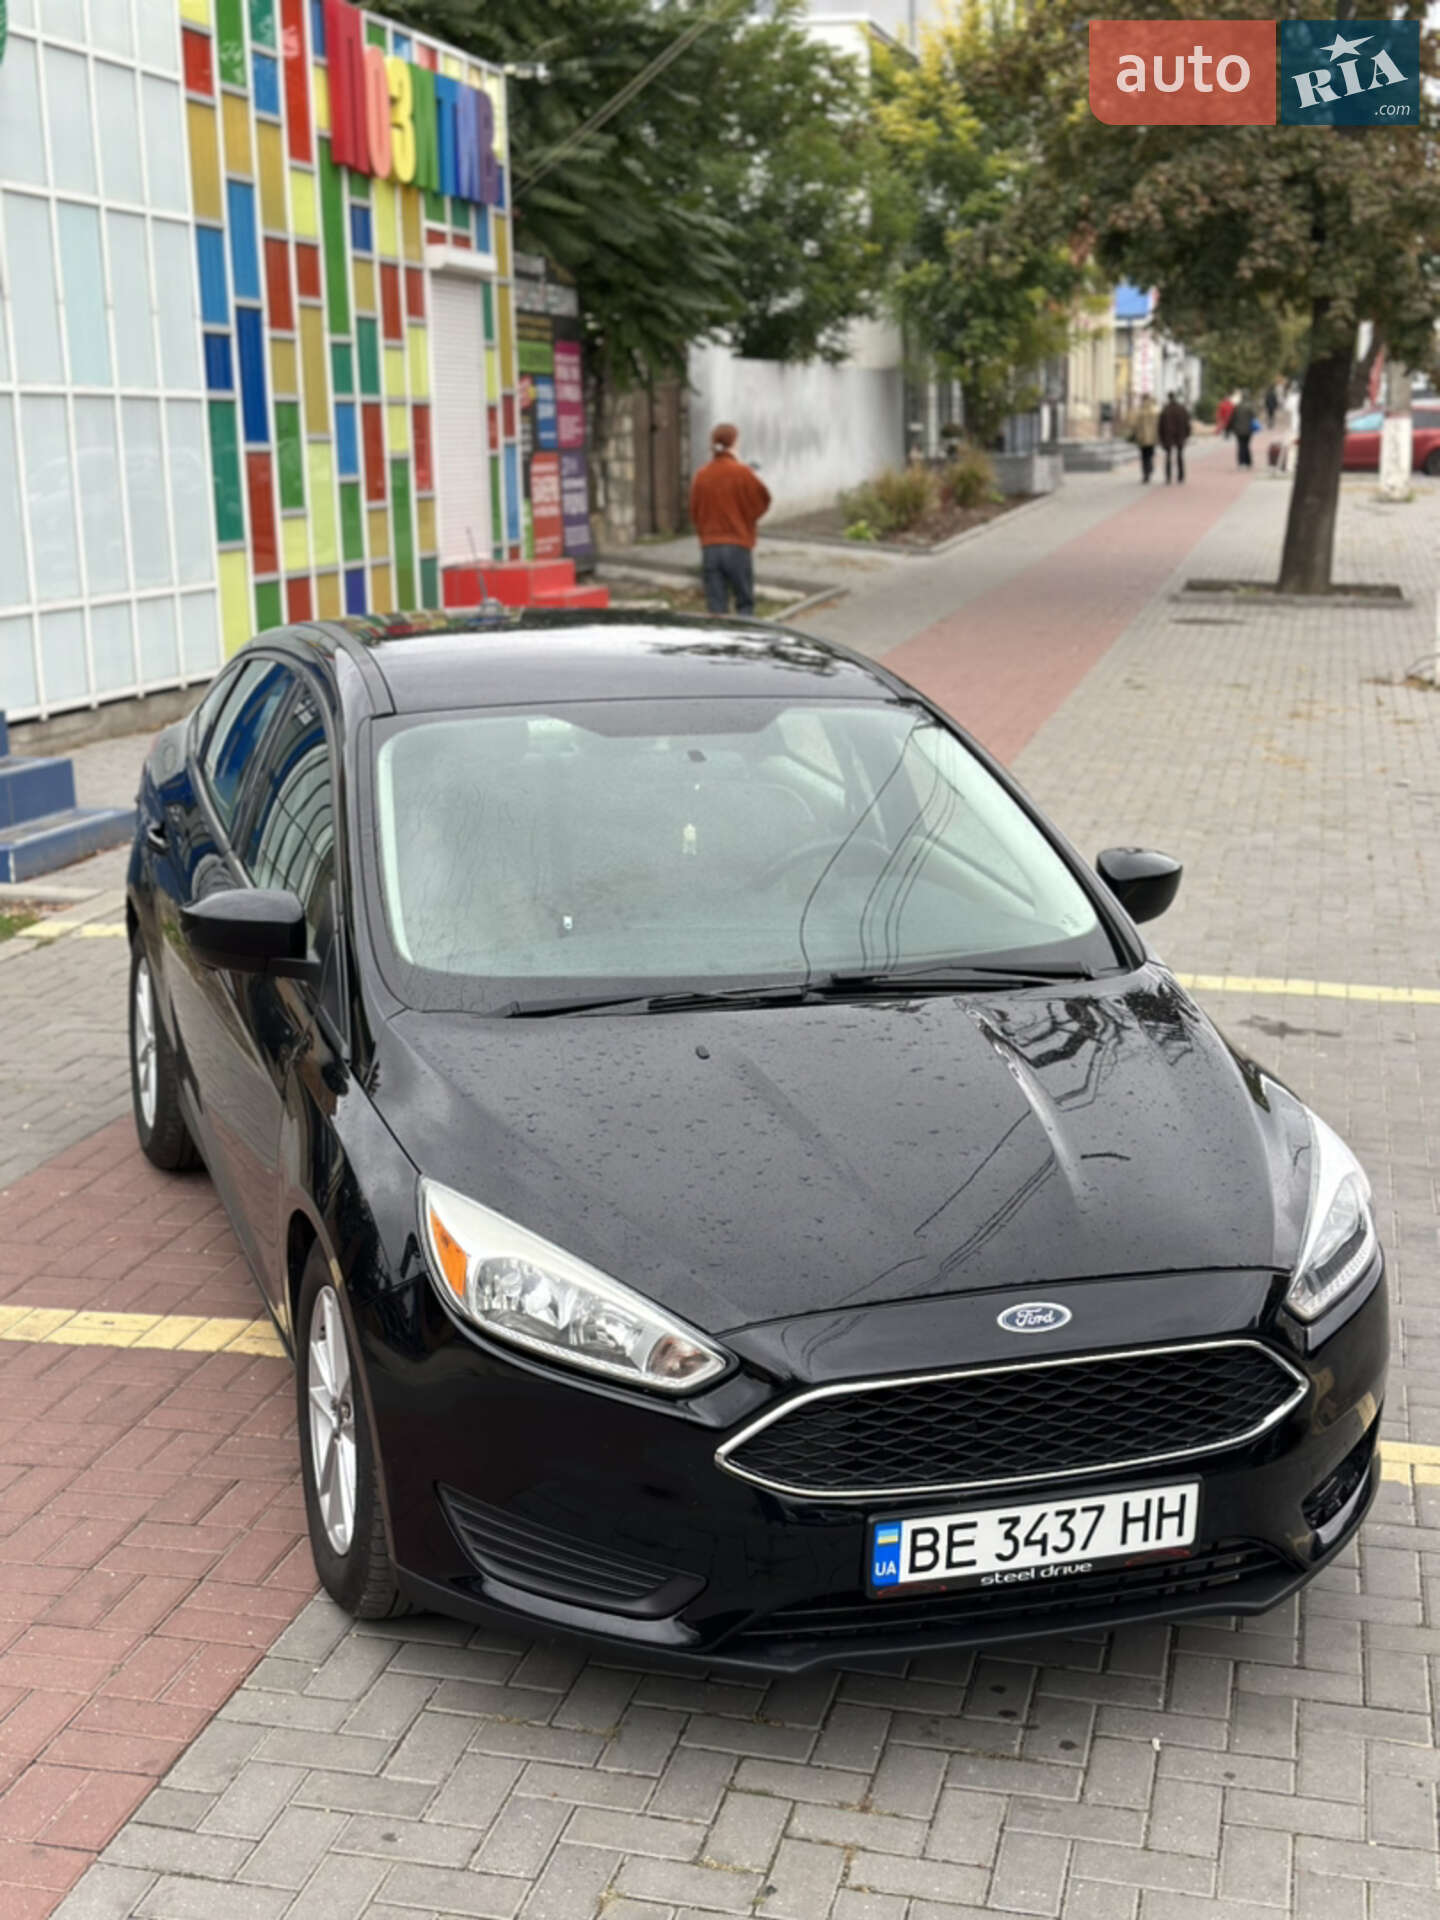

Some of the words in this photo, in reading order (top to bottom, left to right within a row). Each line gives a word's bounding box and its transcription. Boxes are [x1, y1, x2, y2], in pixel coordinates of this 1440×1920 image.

[1014, 1306, 1057, 1327] Ford
[907, 1521, 978, 1574] BE
[994, 1504, 1105, 1562] 3437
[1120, 1493, 1187, 1546] HH
[874, 1560, 897, 1577] UA
[980, 1567, 1036, 1586] steel
[1040, 1561, 1093, 1579] drive
